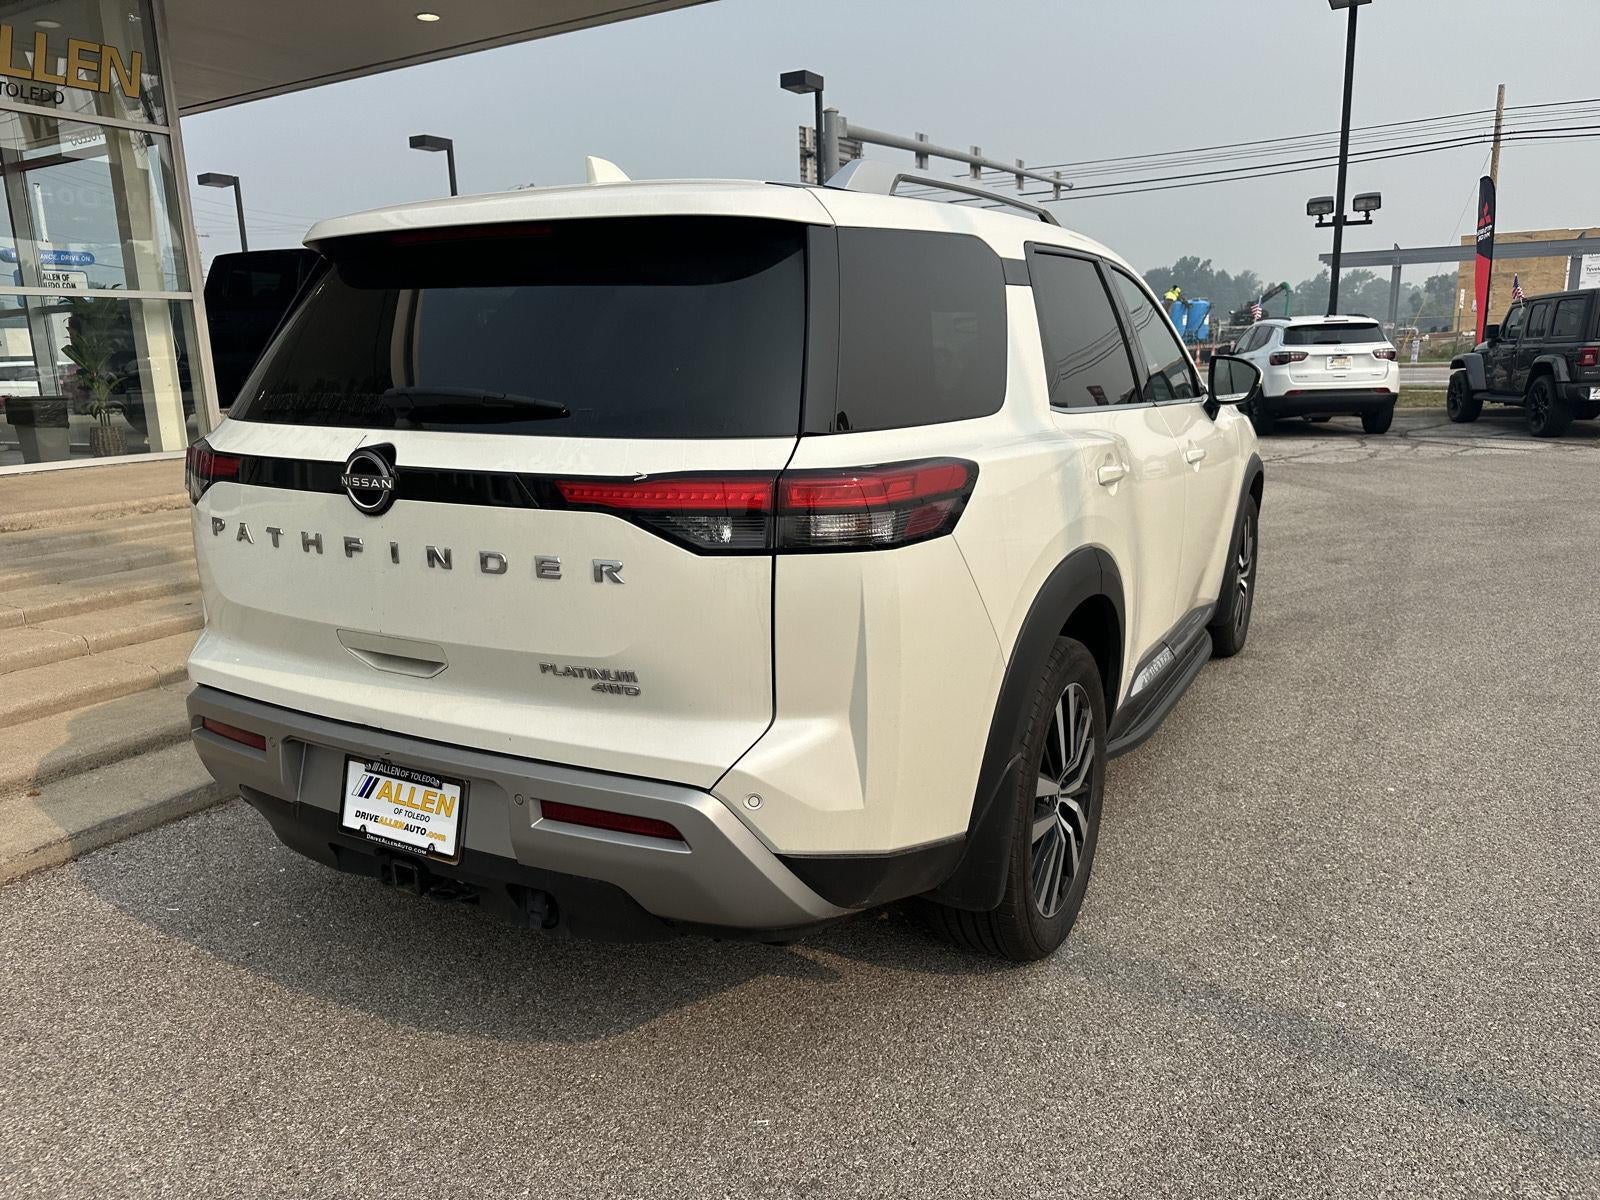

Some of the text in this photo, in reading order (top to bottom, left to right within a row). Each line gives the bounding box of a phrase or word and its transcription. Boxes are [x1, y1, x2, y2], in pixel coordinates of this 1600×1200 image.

[60, 253, 80, 262] DRIVE
[43, 273, 70, 281] ALLEN OF
[341, 475, 392, 489] NISSAN
[210, 515, 627, 585] PATHFINDER
[538, 661, 639, 683] PLATINUM
[591, 682, 641, 696] 4WD
[379, 762, 436, 784] ALLEN OF TOLEDO
[375, 780, 457, 818] ALLEN
[393, 807, 431, 823] OF TOLEDO
